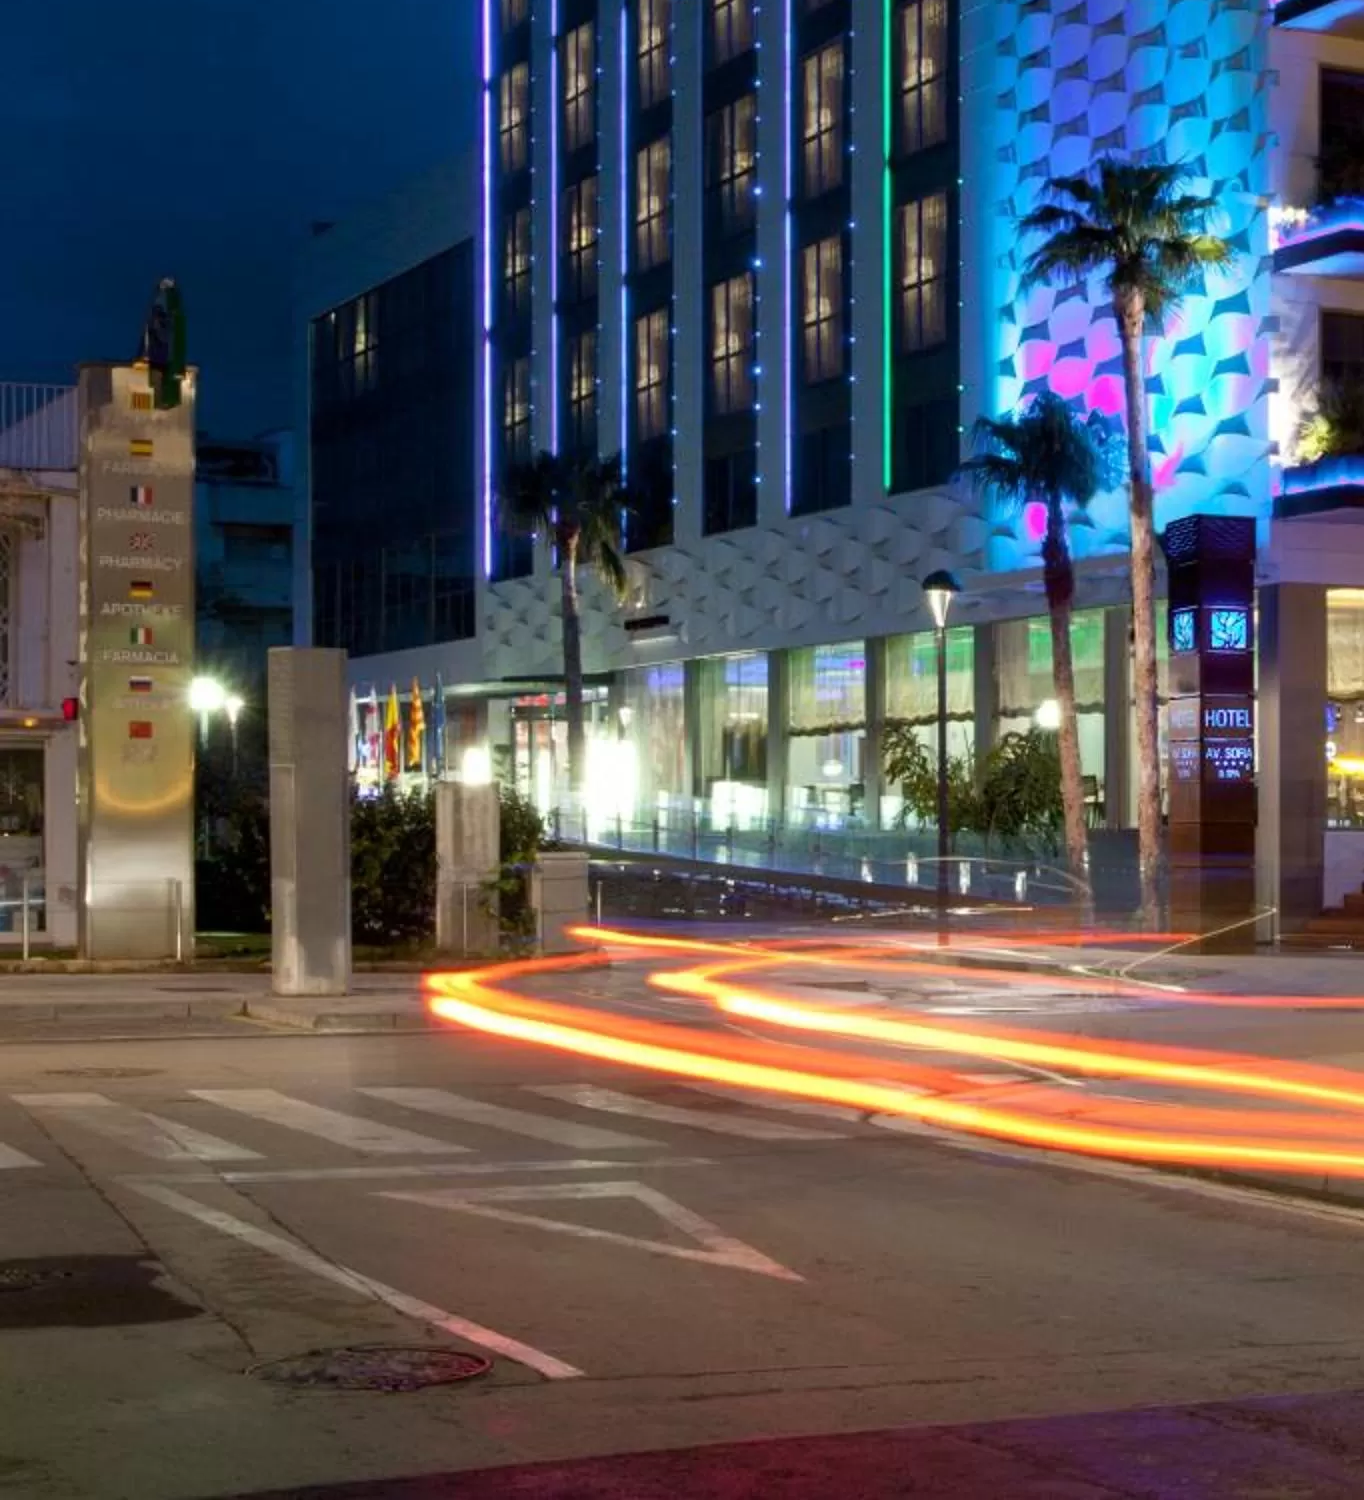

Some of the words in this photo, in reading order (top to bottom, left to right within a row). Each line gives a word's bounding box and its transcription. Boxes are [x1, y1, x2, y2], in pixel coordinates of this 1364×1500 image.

[103, 651, 178, 665] FARMACIA
[1205, 708, 1252, 727] HOTEL
[1205, 747, 1222, 759] AV.
